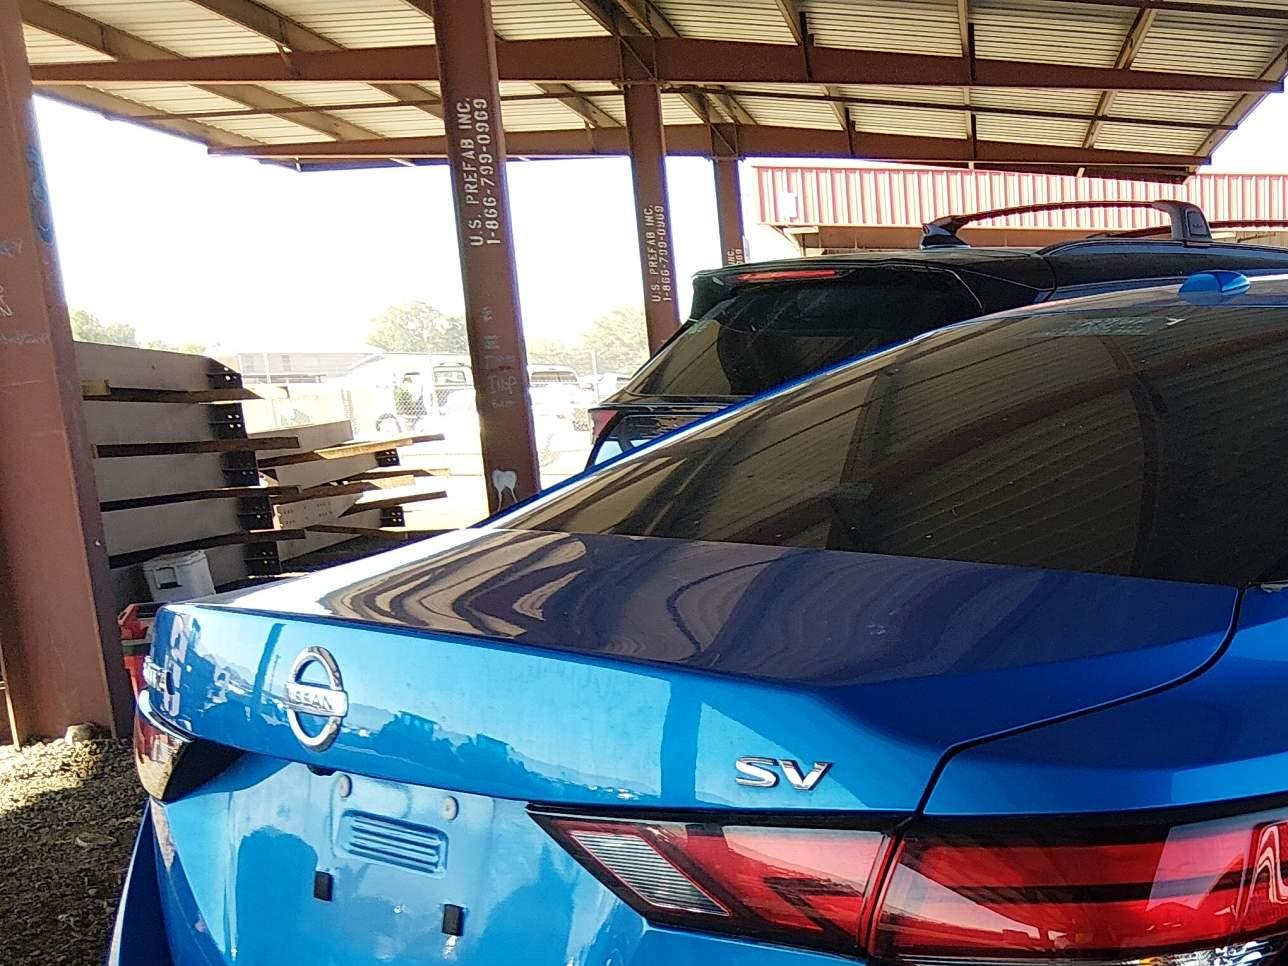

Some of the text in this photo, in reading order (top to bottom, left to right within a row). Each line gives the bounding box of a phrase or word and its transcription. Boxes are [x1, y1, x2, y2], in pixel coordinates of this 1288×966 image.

[456, 97, 485, 246] U.S. PREFAB INC.
[473, 98, 501, 244] 1-866-799-0969
[643, 204, 661, 302] U.S. PREFAB INC.
[735, 756, 832, 791] SV
